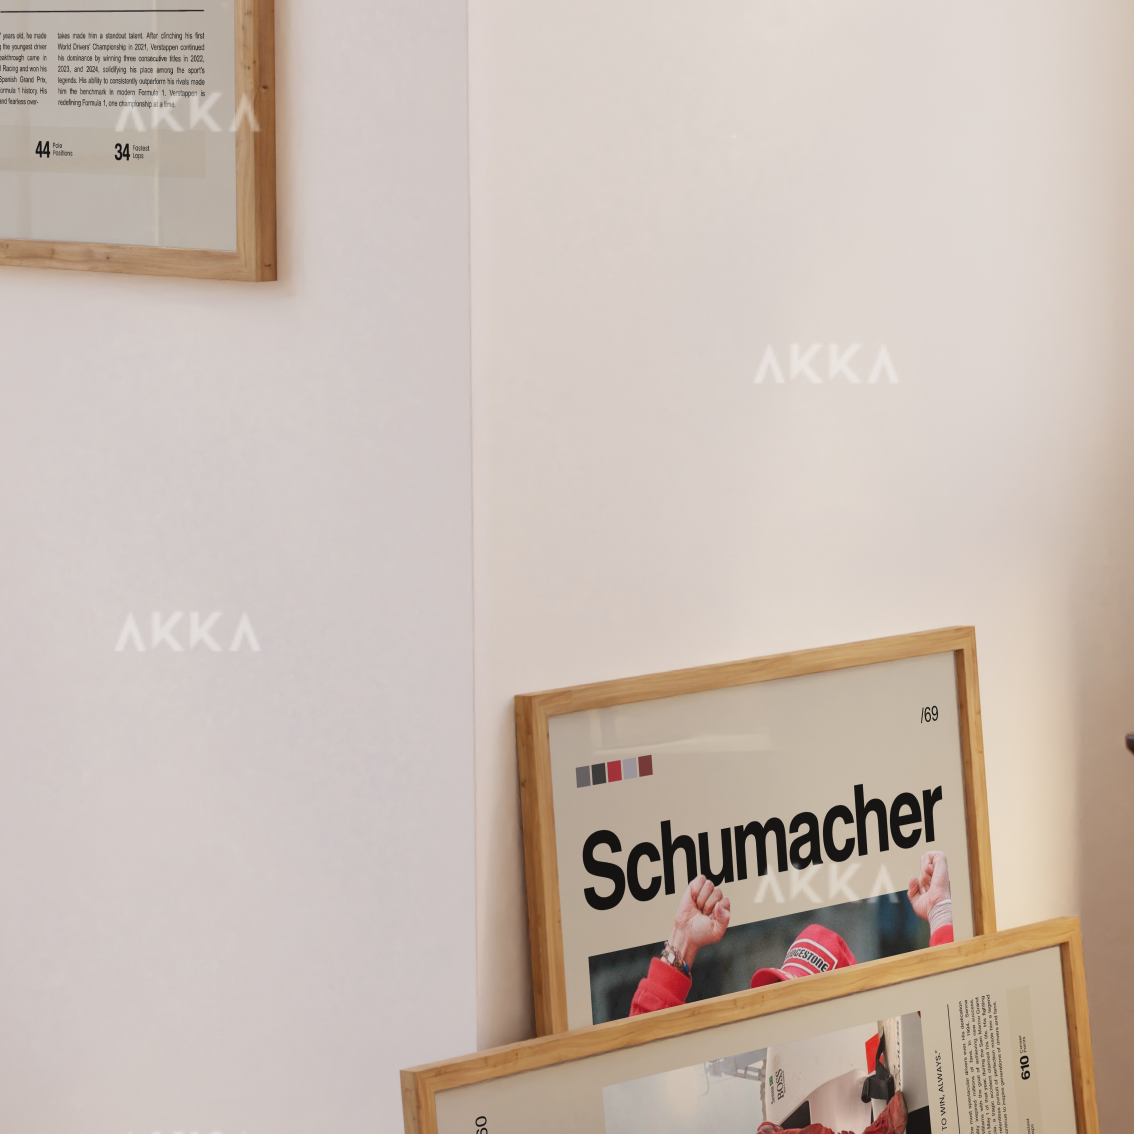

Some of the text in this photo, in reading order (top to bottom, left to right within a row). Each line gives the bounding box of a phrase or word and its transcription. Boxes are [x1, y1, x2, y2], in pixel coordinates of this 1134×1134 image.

[92, 43, 126, 51] Championship
[150, 44, 178, 52] Verstappen
[103, 66, 126, 74] solidifying
[35, 140, 50, 158] 44
[114, 143, 130, 161] 34
[920, 705, 939, 724] /69
[582, 783, 943, 911] Schumacher
[1019, 1055, 1031, 1080] 610
[775, 1068, 784, 1101] BOSS
[941, 1118, 947, 1131] TO
